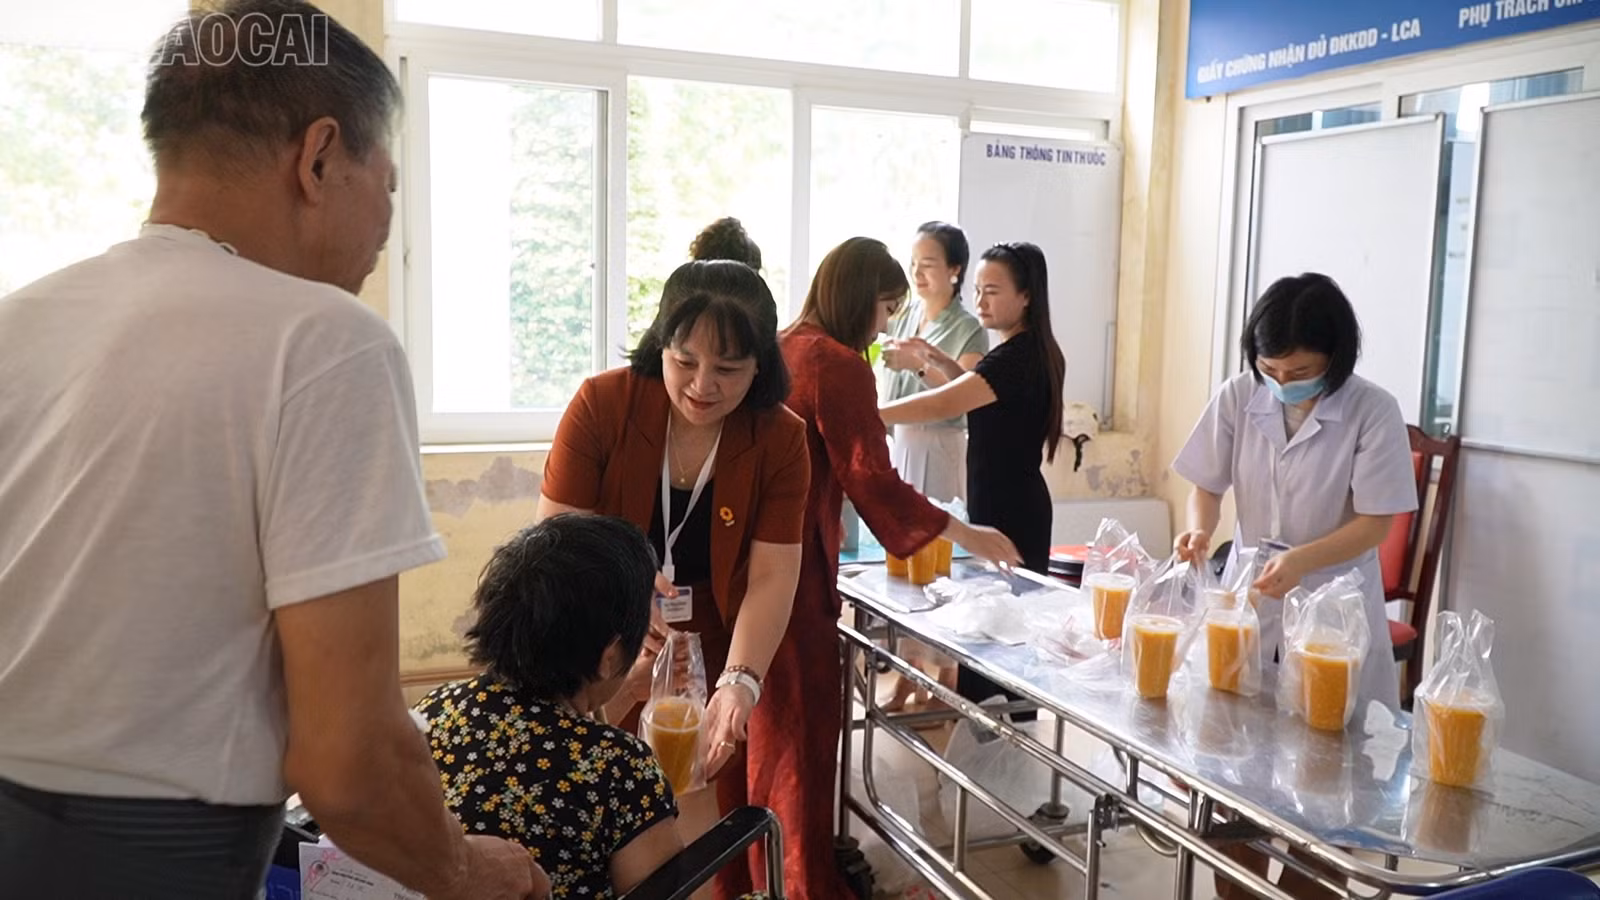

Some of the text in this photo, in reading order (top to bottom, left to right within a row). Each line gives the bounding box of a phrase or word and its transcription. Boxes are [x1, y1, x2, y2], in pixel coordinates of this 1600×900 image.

[1458, 3, 1491, 28] PHỤ
[1391, 18, 1421, 42] LCA
[986, 139, 1016, 159] BẢNG
[1020, 144, 1053, 162] THÔNG
